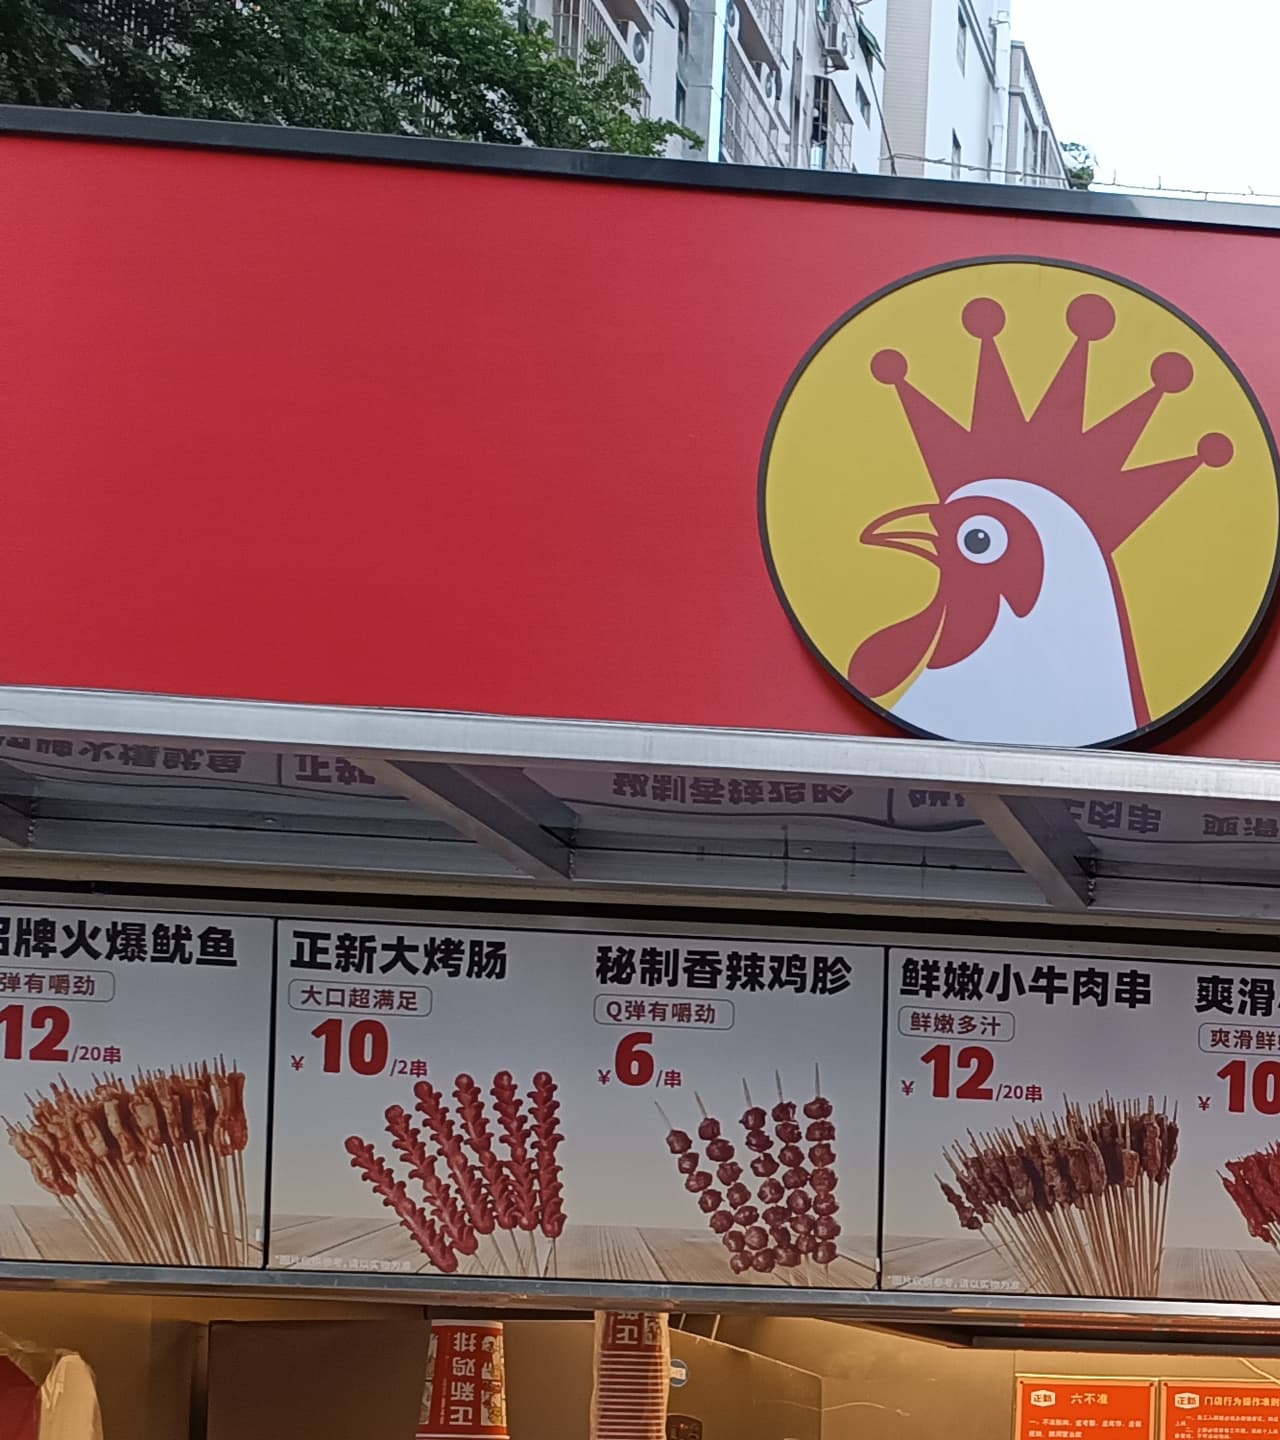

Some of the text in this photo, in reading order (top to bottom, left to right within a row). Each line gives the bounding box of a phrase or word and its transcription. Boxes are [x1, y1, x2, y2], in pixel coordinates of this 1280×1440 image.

[0, 916, 238, 967] 牌火爆鱿鱼
[290, 930, 507, 980] 正新大烤肠
[595, 946, 853, 996] 秘制香辣鸡胗
[900, 957, 1152, 1009] 鲜嫩小牛肉串
[301, 984, 419, 1012] 大口超满足
[606, 1000, 716, 1025] Q弹有嚼劲
[910, 1011, 1002, 1037] 鲜嫩多汁
[450, 1331, 477, 1427] 正新鸡排
[1070, 1392, 1109, 1405] 六不准
